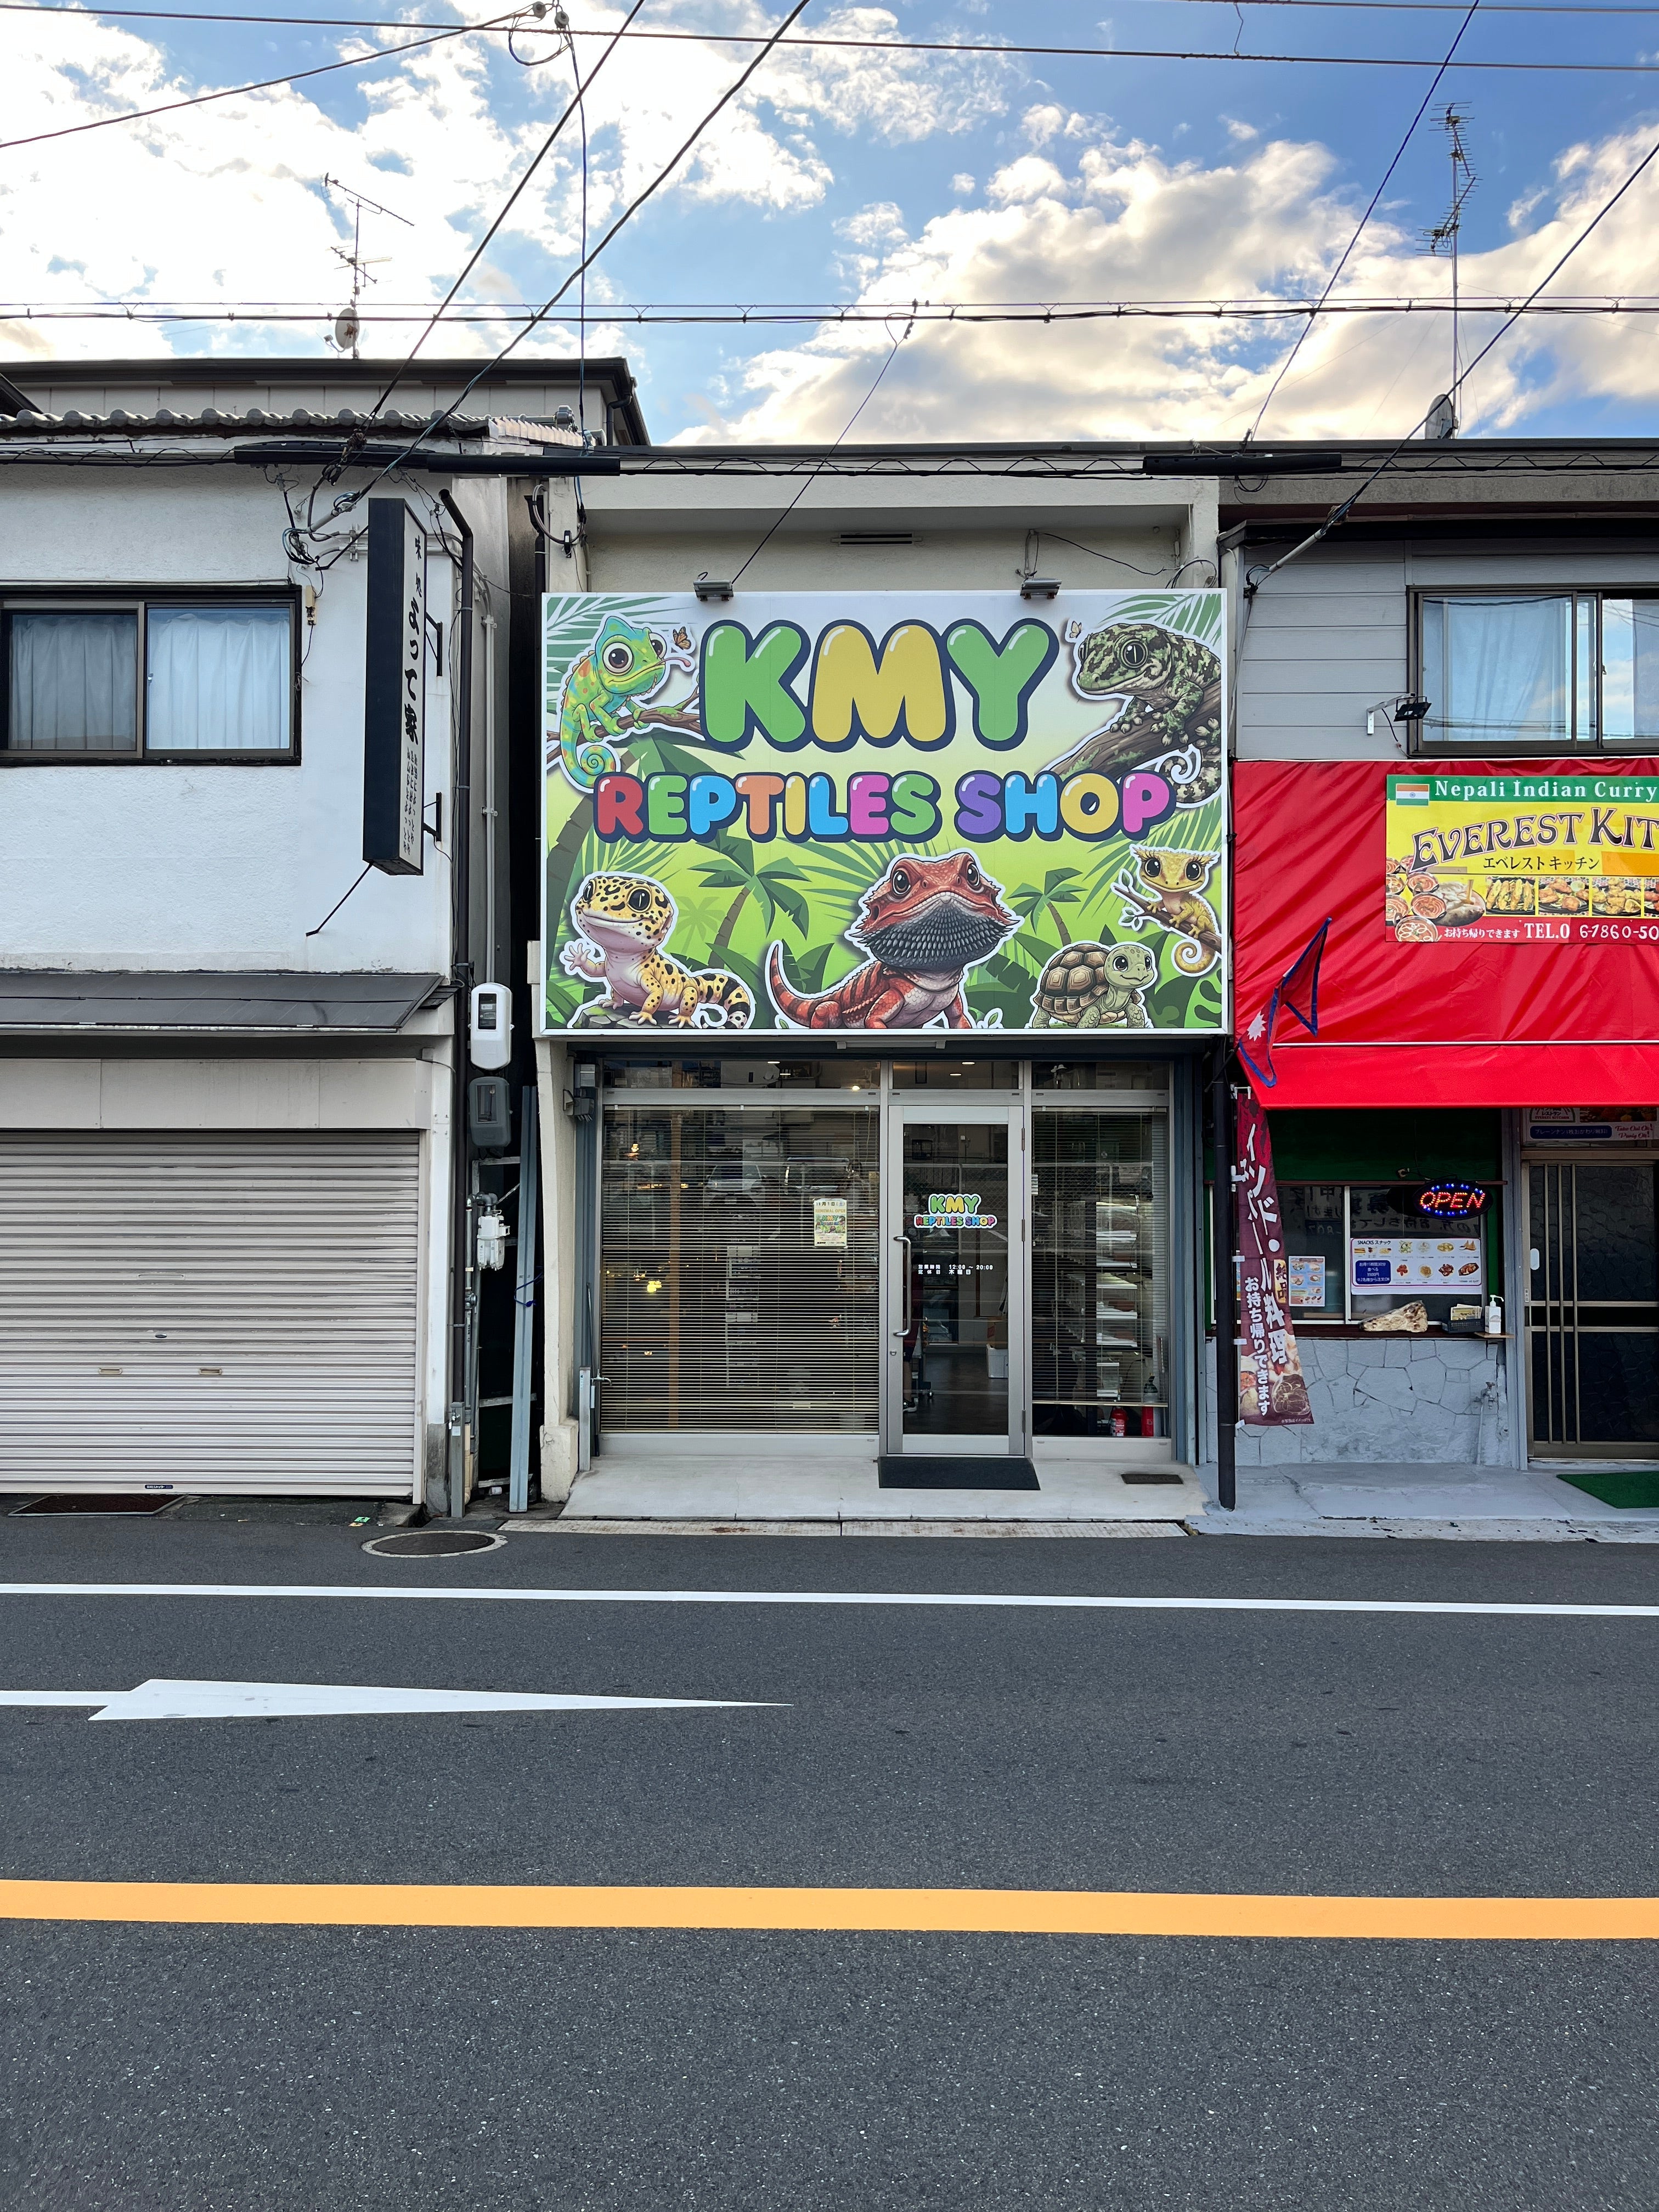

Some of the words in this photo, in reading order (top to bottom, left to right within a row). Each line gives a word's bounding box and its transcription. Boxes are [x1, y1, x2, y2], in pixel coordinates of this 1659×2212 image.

[701, 618, 1059, 752] KMY
[1435, 781, 1505, 801] Nepali
[1514, 781, 1587, 797] Indian
[1594, 781, 1657, 803] Curry
[594, 771, 943, 843] REPTILES
[955, 770, 1176, 842] SHOP
[1409, 812, 1584, 873] EVEREST
[1483, 856, 1545, 870] エベレスト
[1550, 856, 1599, 870] キッチン
[1443, 927, 1520, 940] お持ち帰りできます
[930, 1195, 979, 1214] KMY
[1420, 1191, 1486, 1209] OPEN
[916, 1216, 963, 1226] REPTILES
[965, 1216, 996, 1226] SHOP
[1245, 1276, 1271, 1416] お持ち帰りできます
